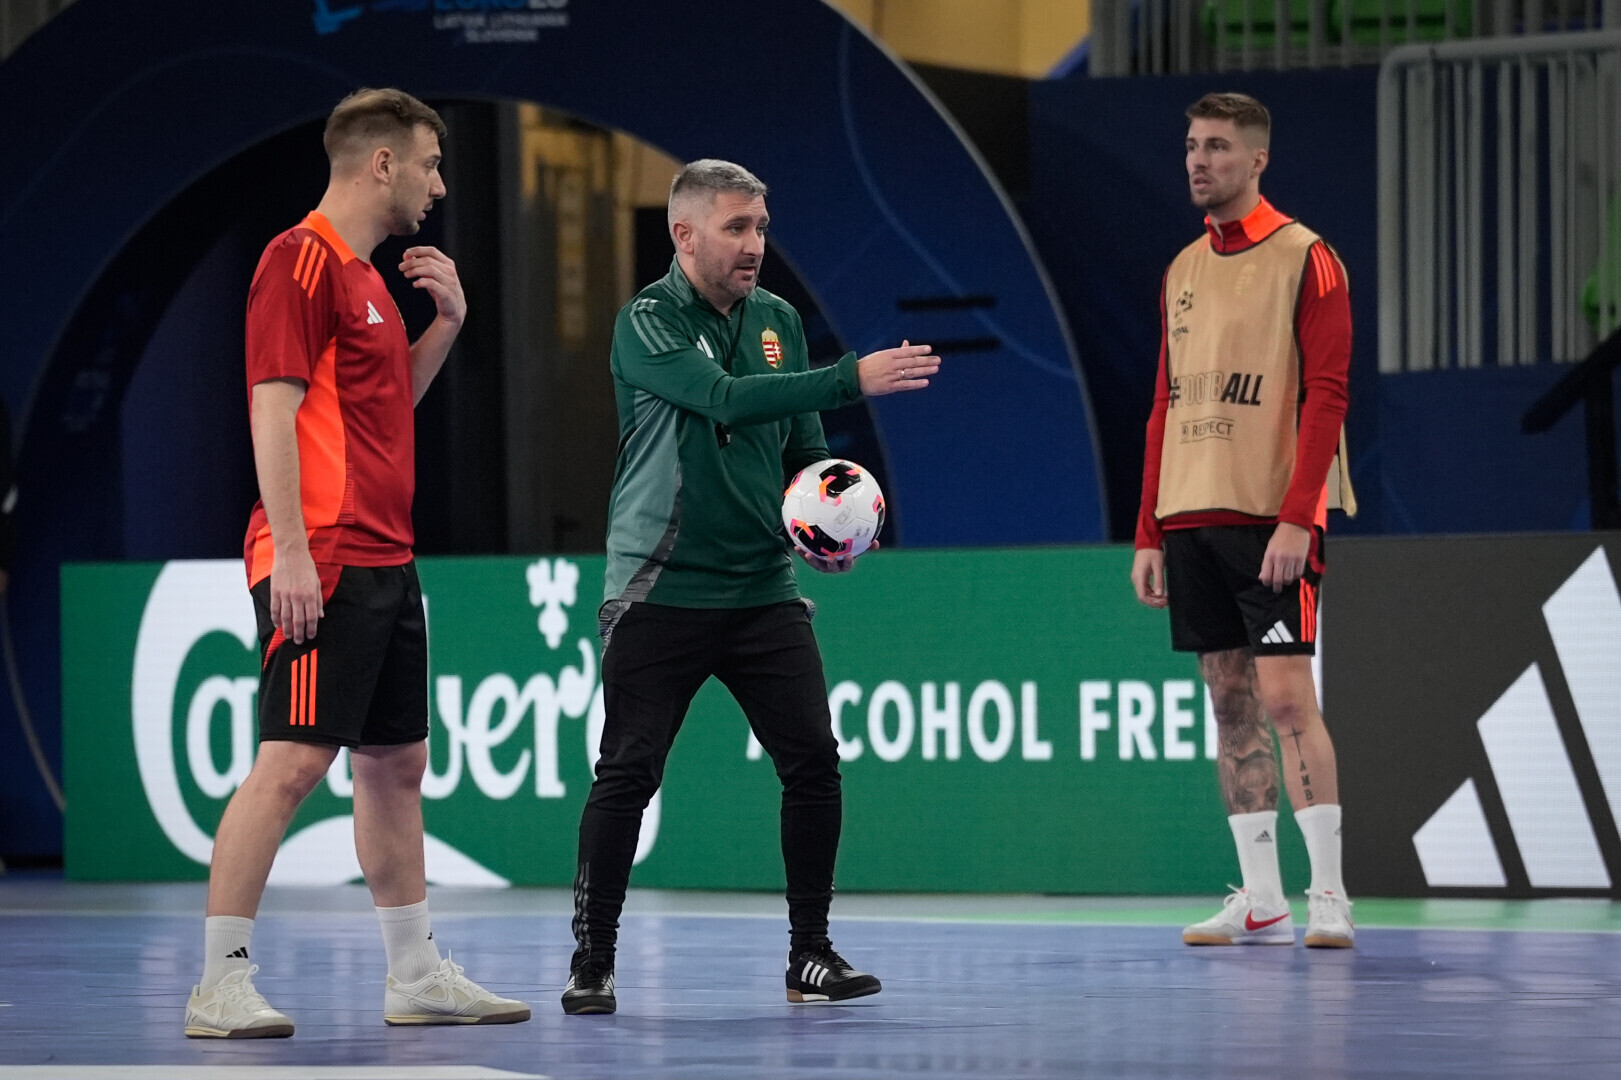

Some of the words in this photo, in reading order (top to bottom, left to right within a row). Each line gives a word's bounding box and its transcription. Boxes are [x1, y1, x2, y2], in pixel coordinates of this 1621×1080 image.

[1168, 370, 1263, 408] #FOOTBALL
[1192, 420, 1234, 437] RESPECT
[746, 680, 1053, 762] COHOL
